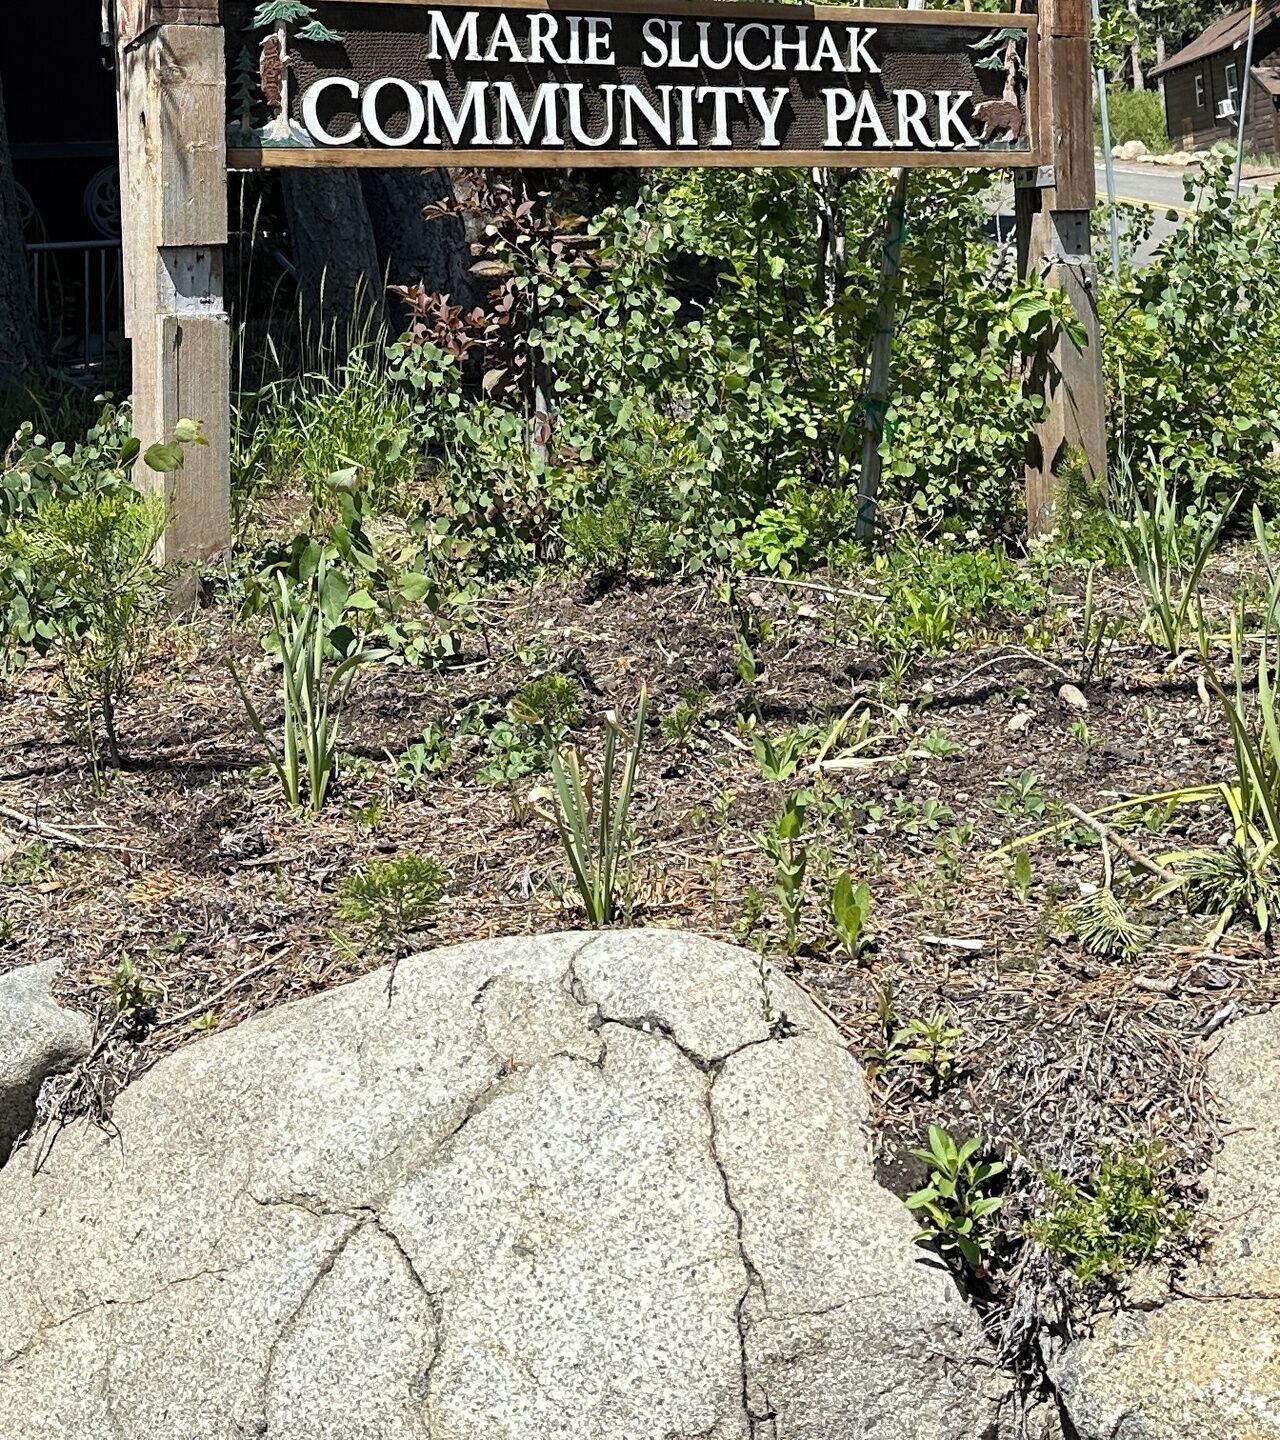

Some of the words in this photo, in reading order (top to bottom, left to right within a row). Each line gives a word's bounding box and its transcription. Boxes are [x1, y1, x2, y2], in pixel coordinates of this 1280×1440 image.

[427, 10, 616, 66] MARIE
[641, 17, 882, 74] SLUCHAK
[302, 76, 790, 147] COMMUNITY
[821, 88, 981, 150] PARK
